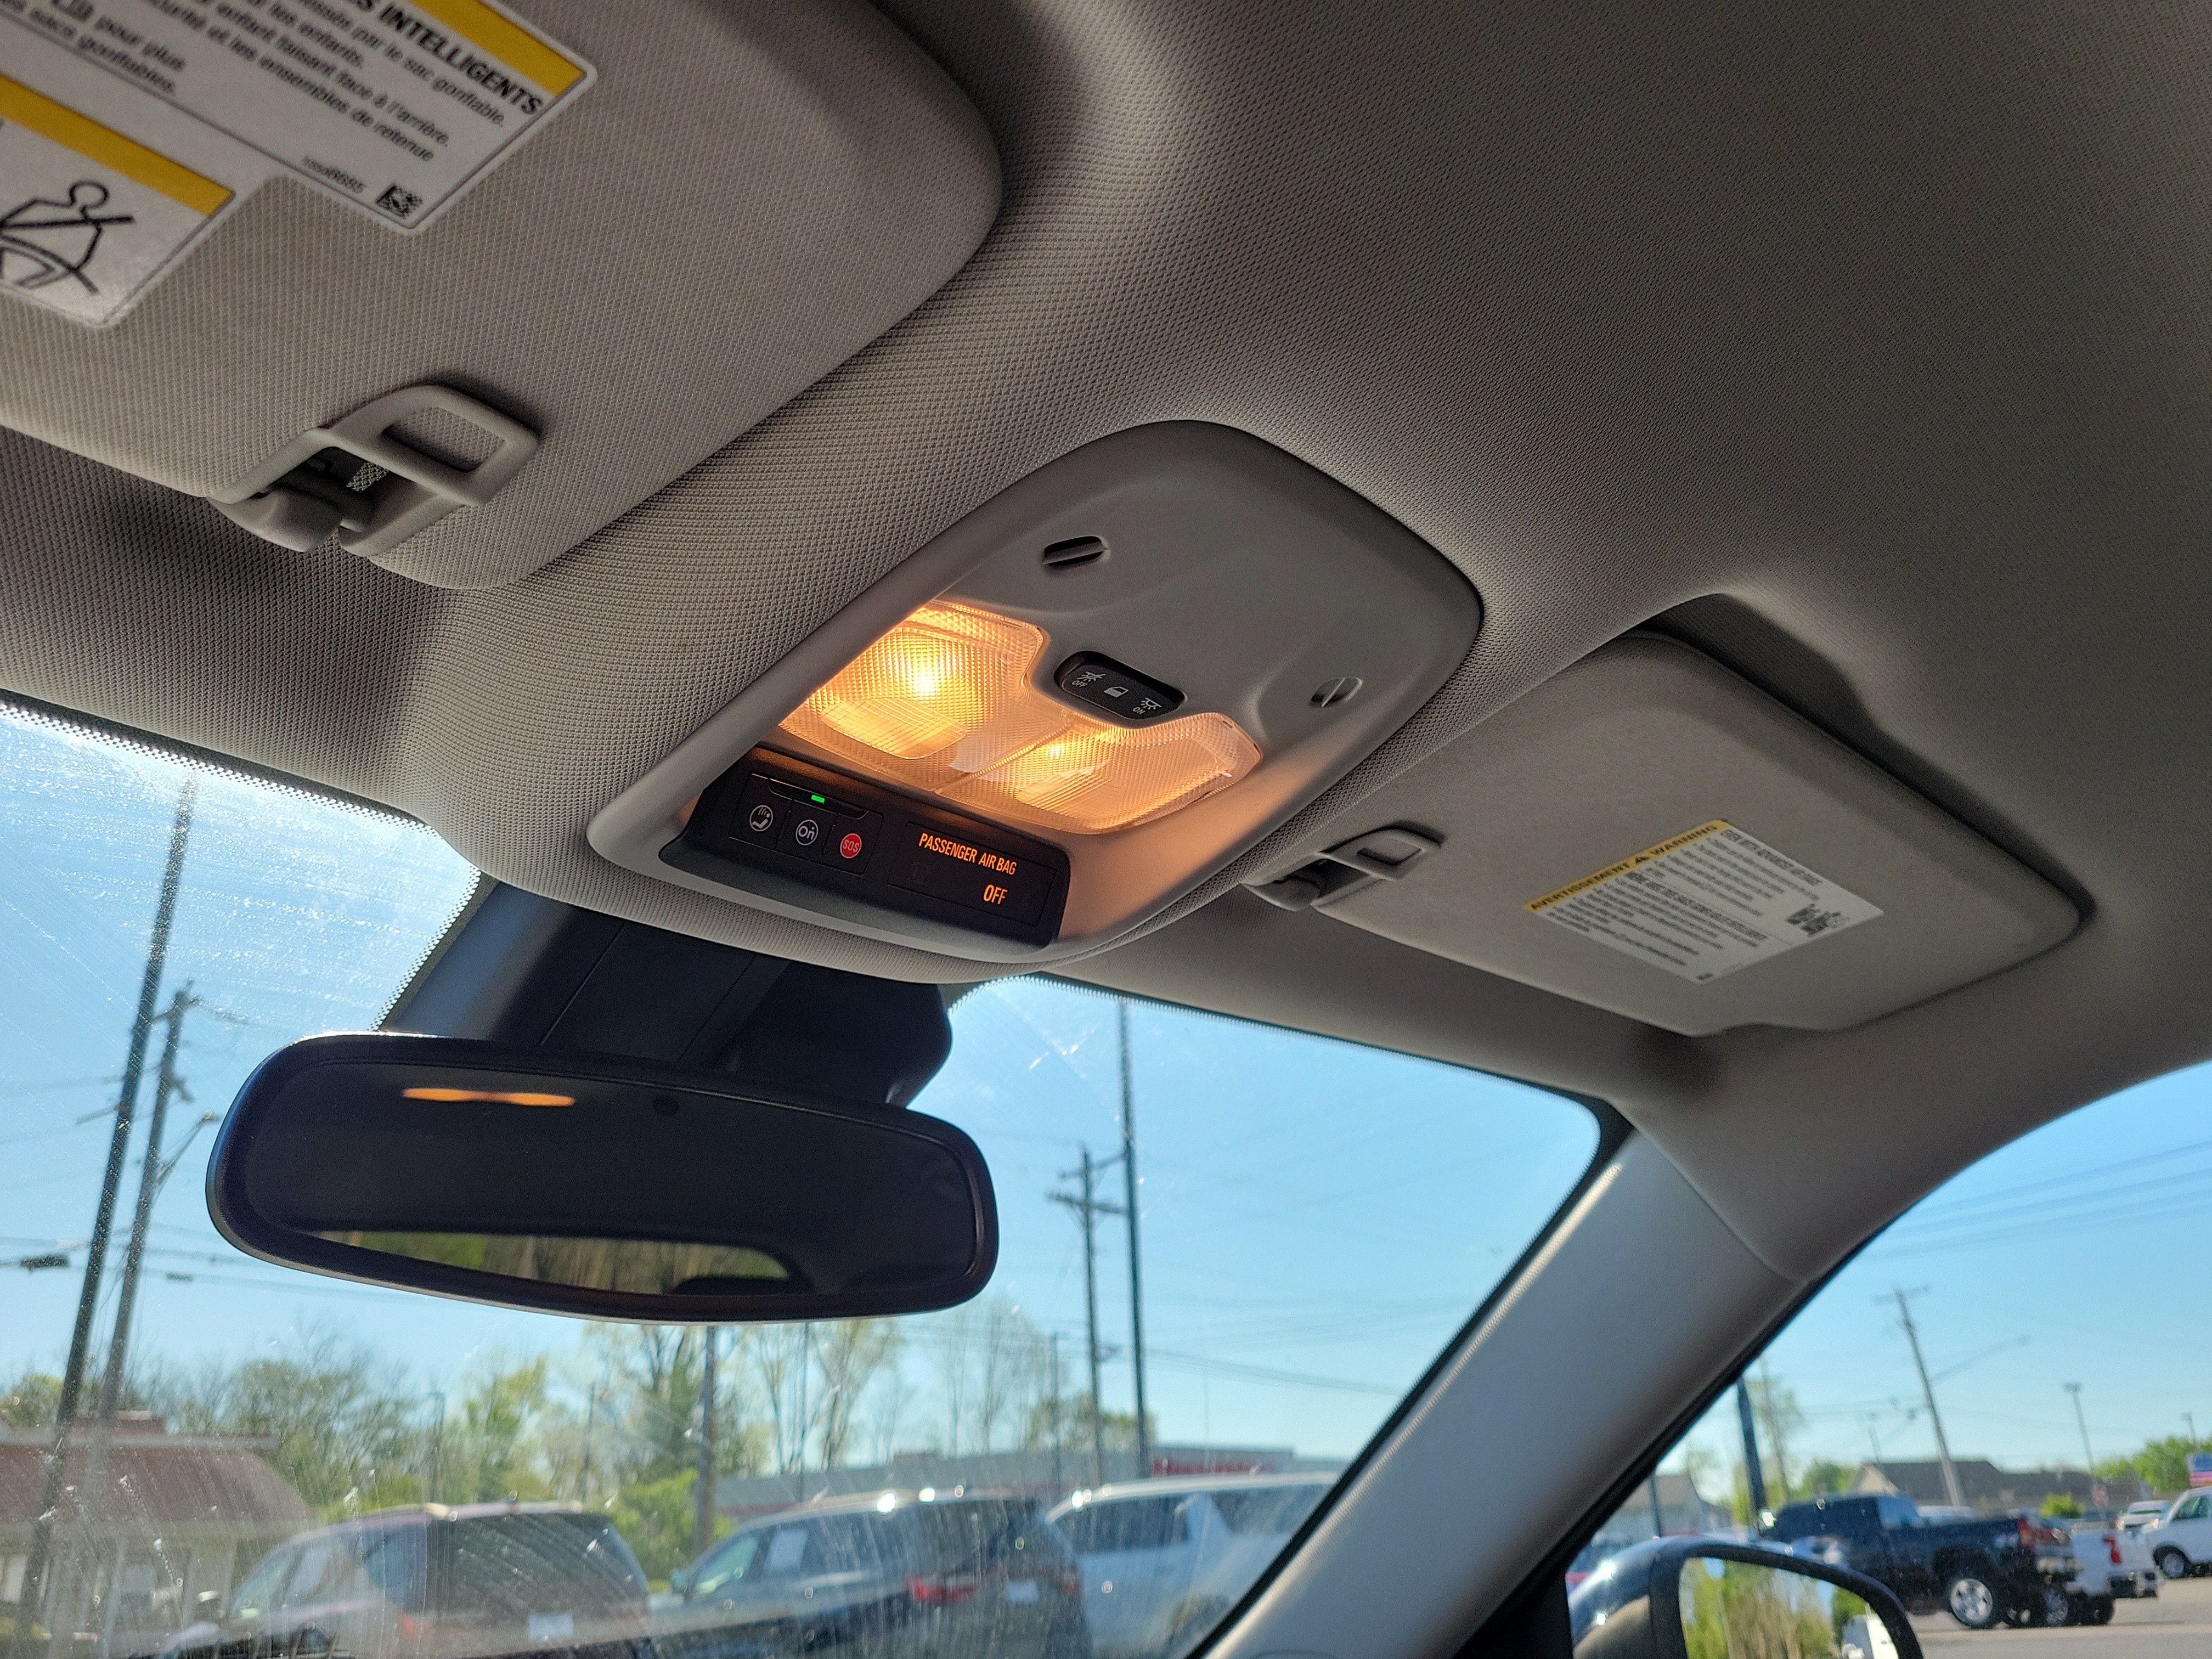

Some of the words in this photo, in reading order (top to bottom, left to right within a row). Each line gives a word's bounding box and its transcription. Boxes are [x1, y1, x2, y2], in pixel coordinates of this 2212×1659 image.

[380, 4, 543, 115] INTELLIGENTS
[384, 43, 403, 62] le
[404, 56, 434, 81] sac
[432, 77, 504, 127] gonflable.
[798, 826, 815, 840] On
[843, 839, 860, 853] SOS
[918, 833, 978, 863] PASSENGER
[983, 884, 1008, 905] OFF
